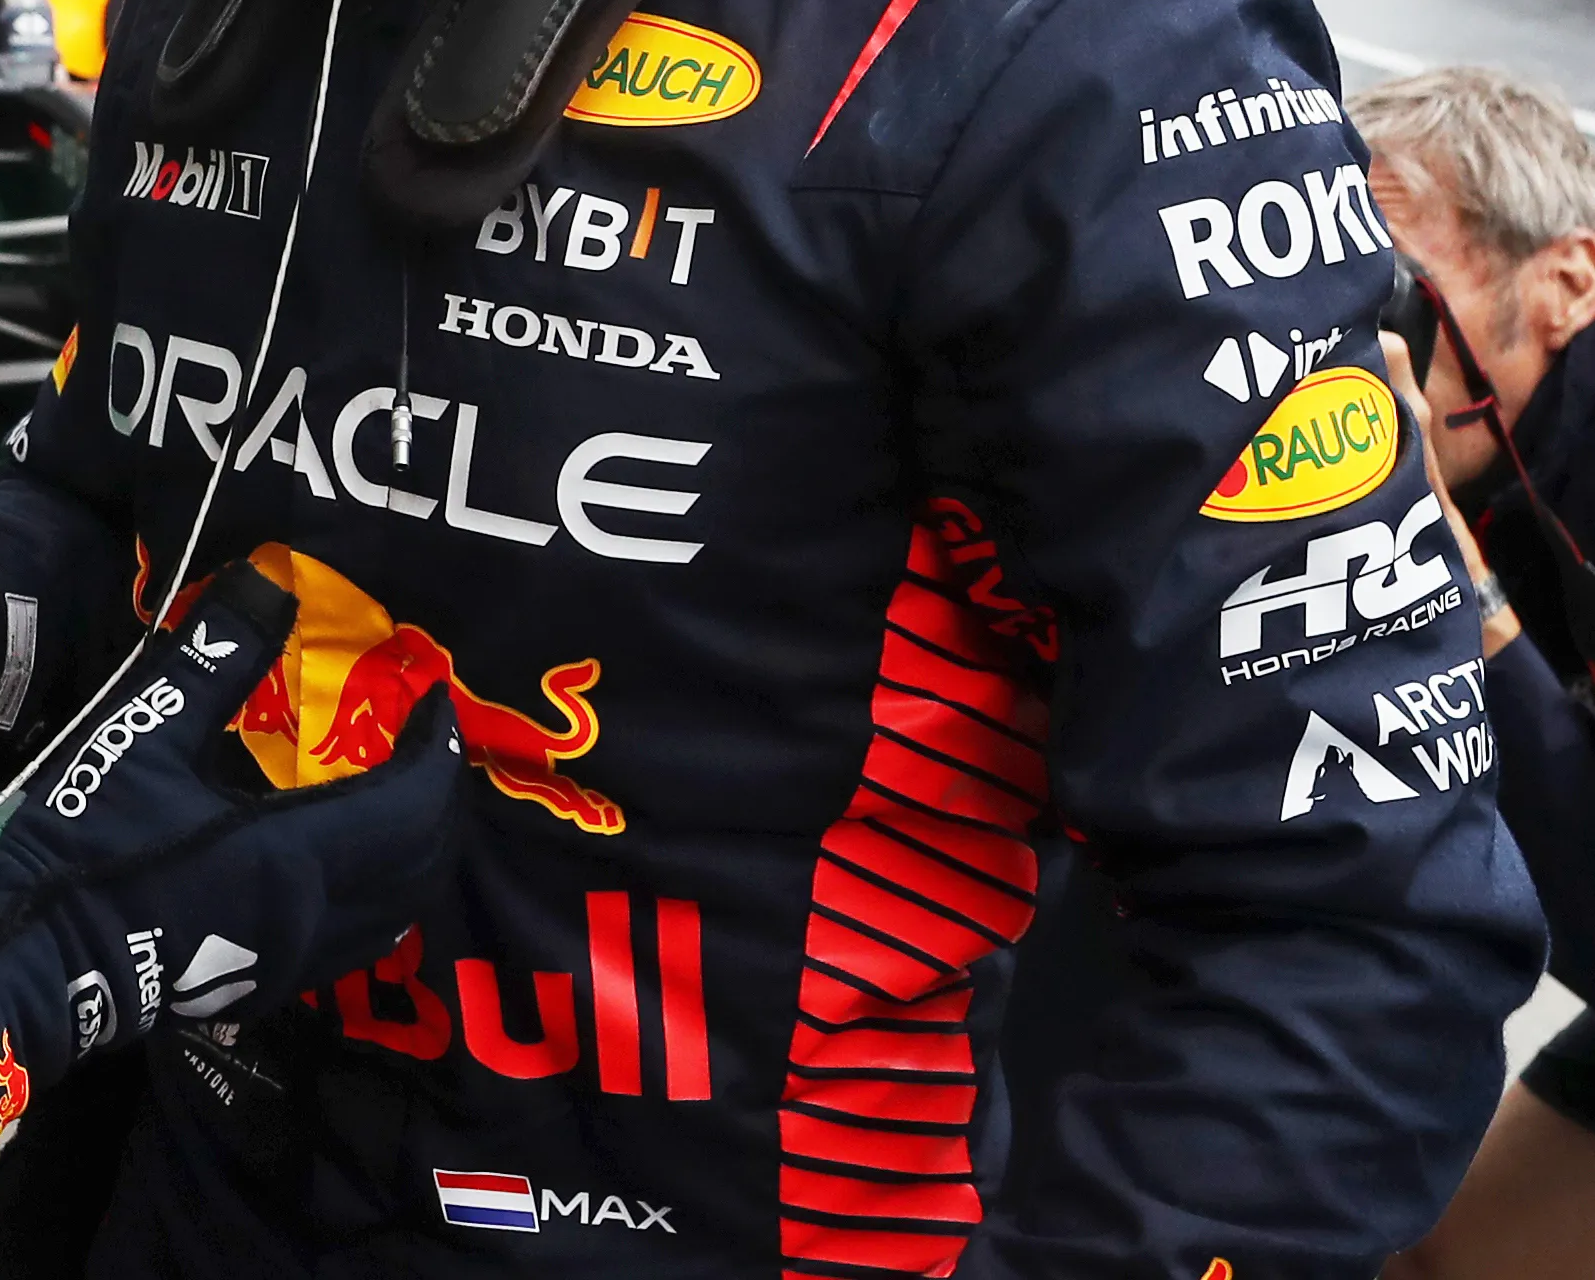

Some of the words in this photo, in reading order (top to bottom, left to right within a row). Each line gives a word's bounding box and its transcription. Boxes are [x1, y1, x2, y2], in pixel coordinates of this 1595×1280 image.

[123, 141, 226, 210] Mobil
[475, 184, 716, 286] BYBIT
[438, 293, 721, 380] HONDA
[108, 322, 713, 564] ORACLE
[1252, 392, 1387, 488] RAUCH
[1220, 491, 1453, 659] HRC
[1362, 585, 1463, 642] RACING
[45, 676, 185, 819] sparco
[1411, 721, 1495, 792] WOL
[539, 1187, 678, 1234] MAX
